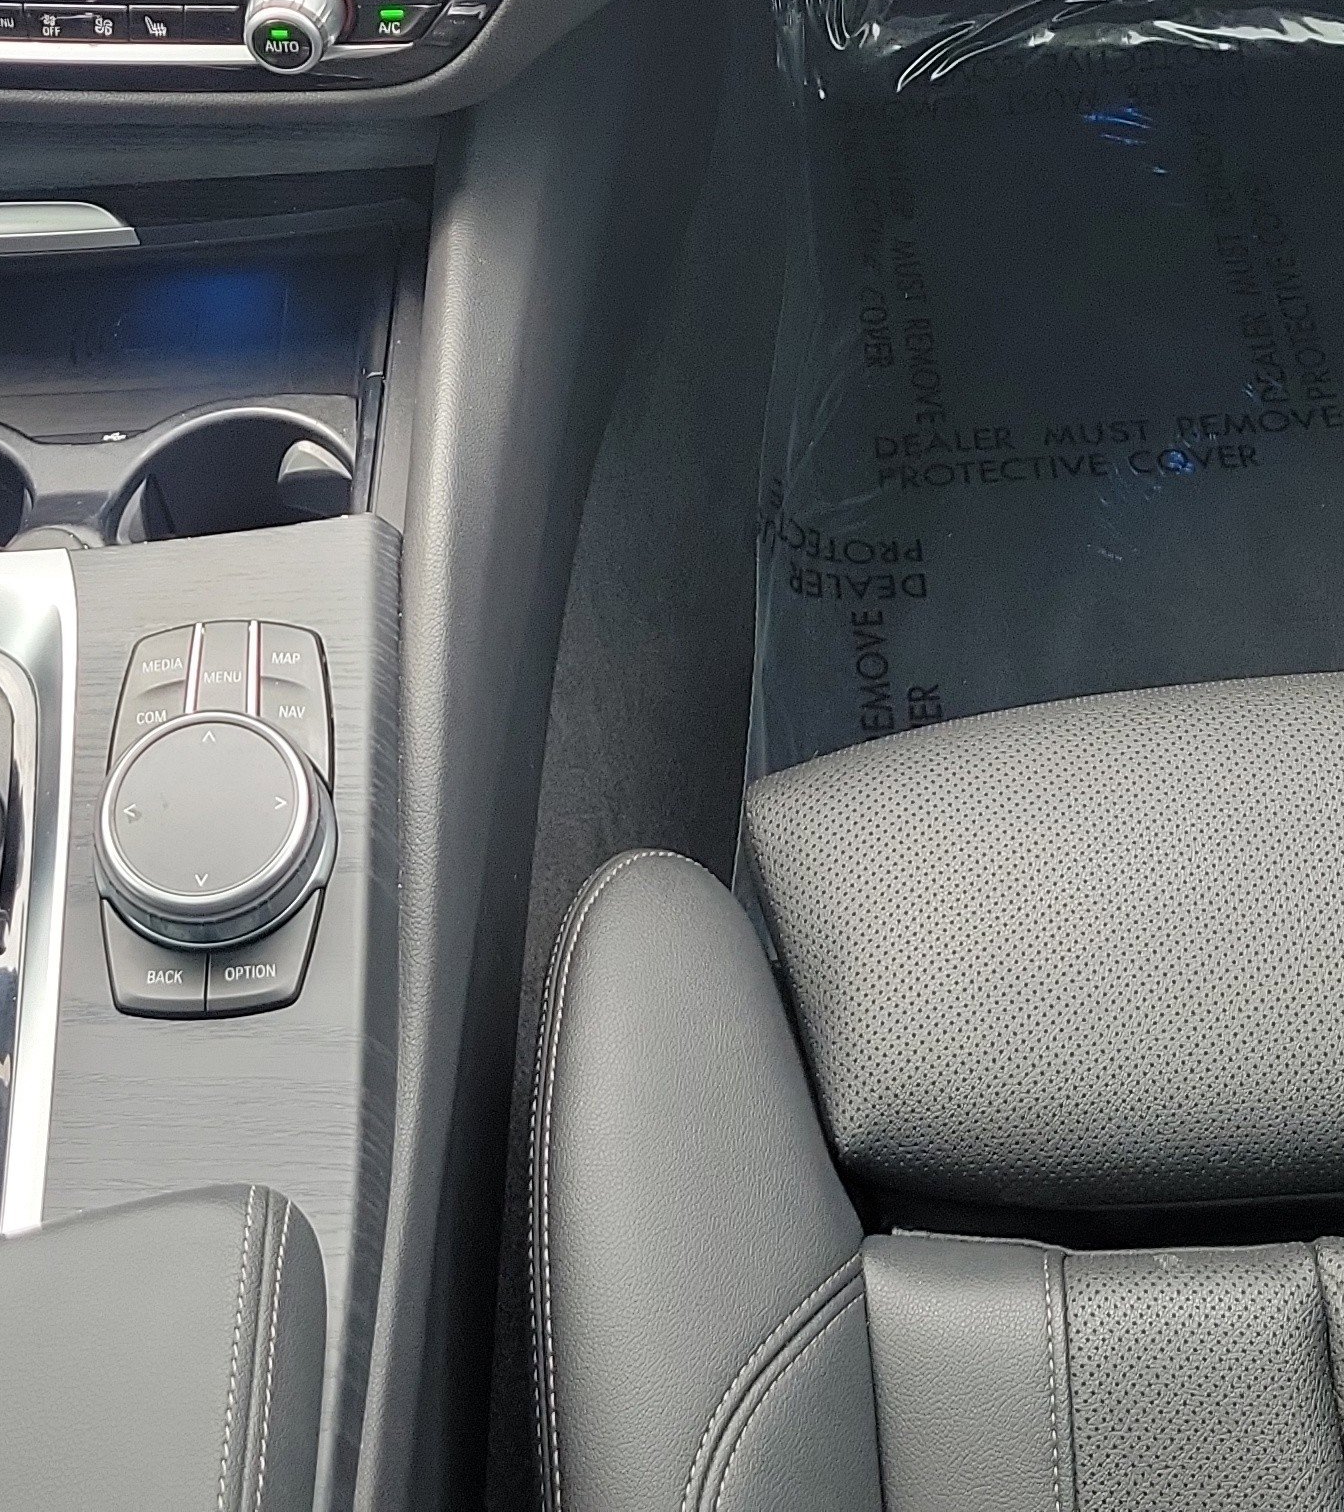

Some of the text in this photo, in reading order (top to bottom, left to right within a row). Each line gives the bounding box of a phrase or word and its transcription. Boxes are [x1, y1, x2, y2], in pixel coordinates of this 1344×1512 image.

[42, 24, 61, 37] OFF
[378, 21, 401, 35] A/C
[265, 39, 300, 54] AUTO
[902, 316, 947, 425] REMOVE
[873, 404, 1344, 461] DEALER MUST REMOVE
[877, 443, 1260, 489] PROTECTIVE COVER
[787, 559, 929, 601] DEALER
[142, 657, 184, 674] MEDIA
[271, 651, 301, 666] MAP
[203, 670, 243, 684] MENU
[849, 608, 897, 734] EMOVE
[136, 709, 168, 725] COM
[278, 705, 306, 720] NAV
[146, 969, 184, 985] BACK
[224, 963, 277, 982] OPTION
